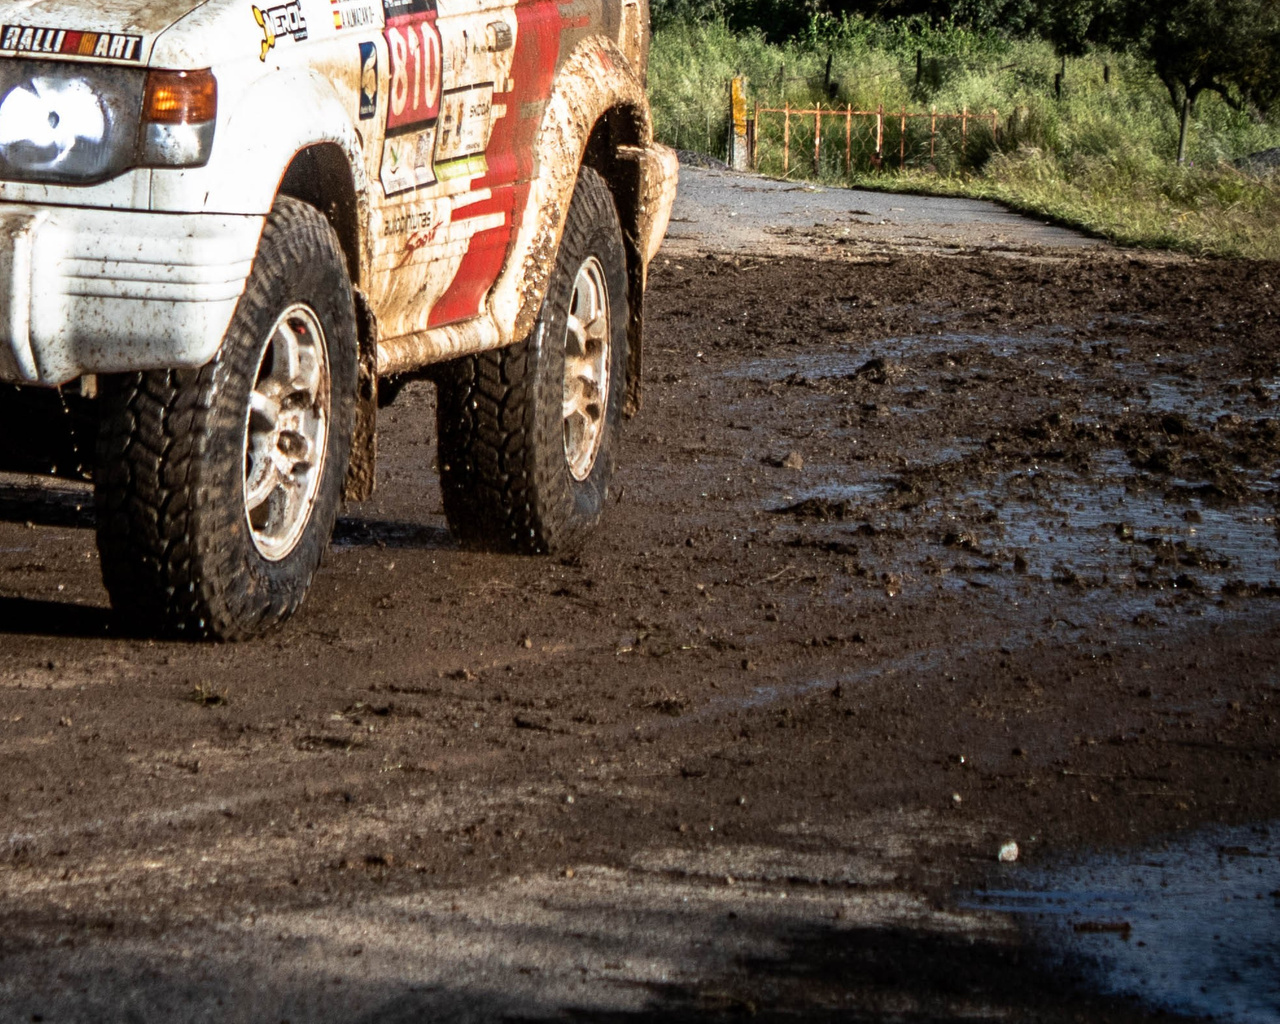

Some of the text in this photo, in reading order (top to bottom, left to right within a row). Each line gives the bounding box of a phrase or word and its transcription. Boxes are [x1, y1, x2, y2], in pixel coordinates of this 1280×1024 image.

[2, 26, 140, 60] RALLI ART
[389, 21, 441, 116] 810
